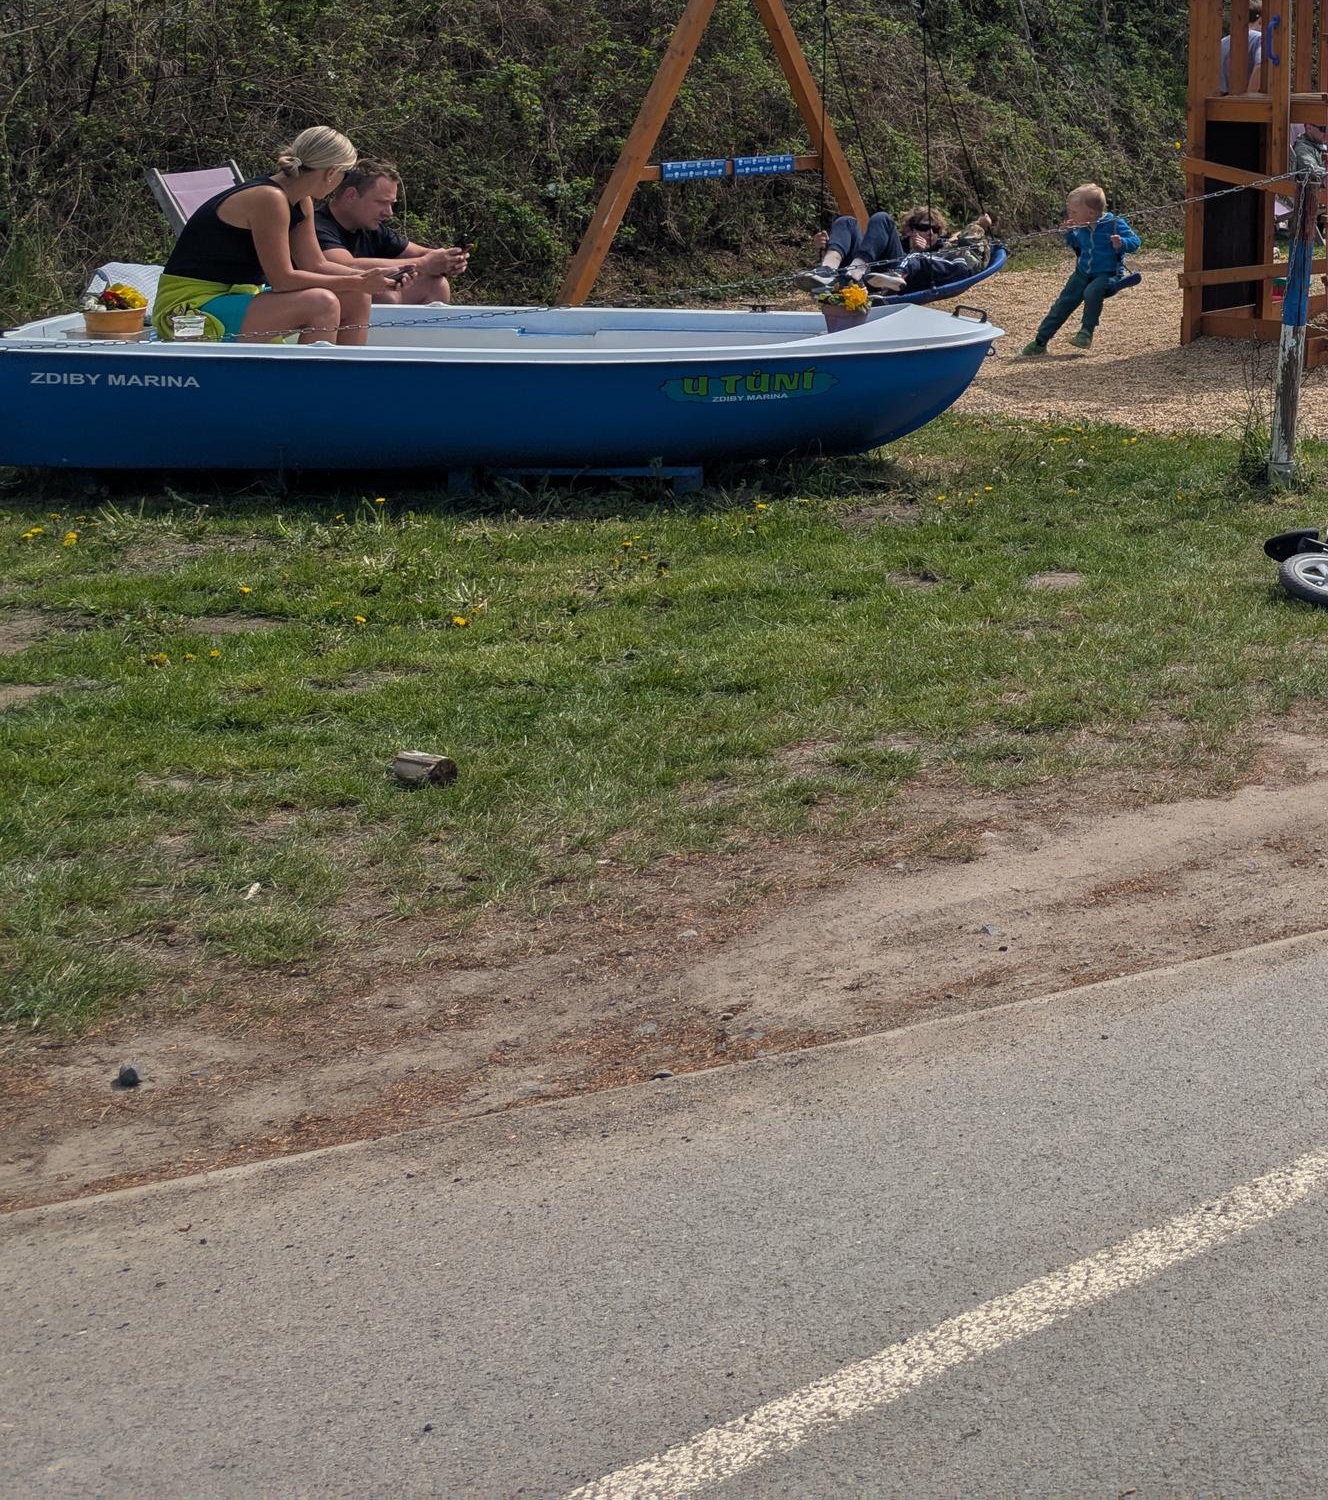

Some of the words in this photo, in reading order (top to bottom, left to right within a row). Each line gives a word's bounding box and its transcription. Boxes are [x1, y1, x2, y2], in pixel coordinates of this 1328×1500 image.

[30, 372, 101, 385] ZDIBY
[108, 374, 201, 388] MARINA
[682, 375, 709, 396] U
[720, 367, 816, 395] TŮNÍ
[712, 394, 745, 403] ZDIBY
[747, 392, 789, 401] MARINA
